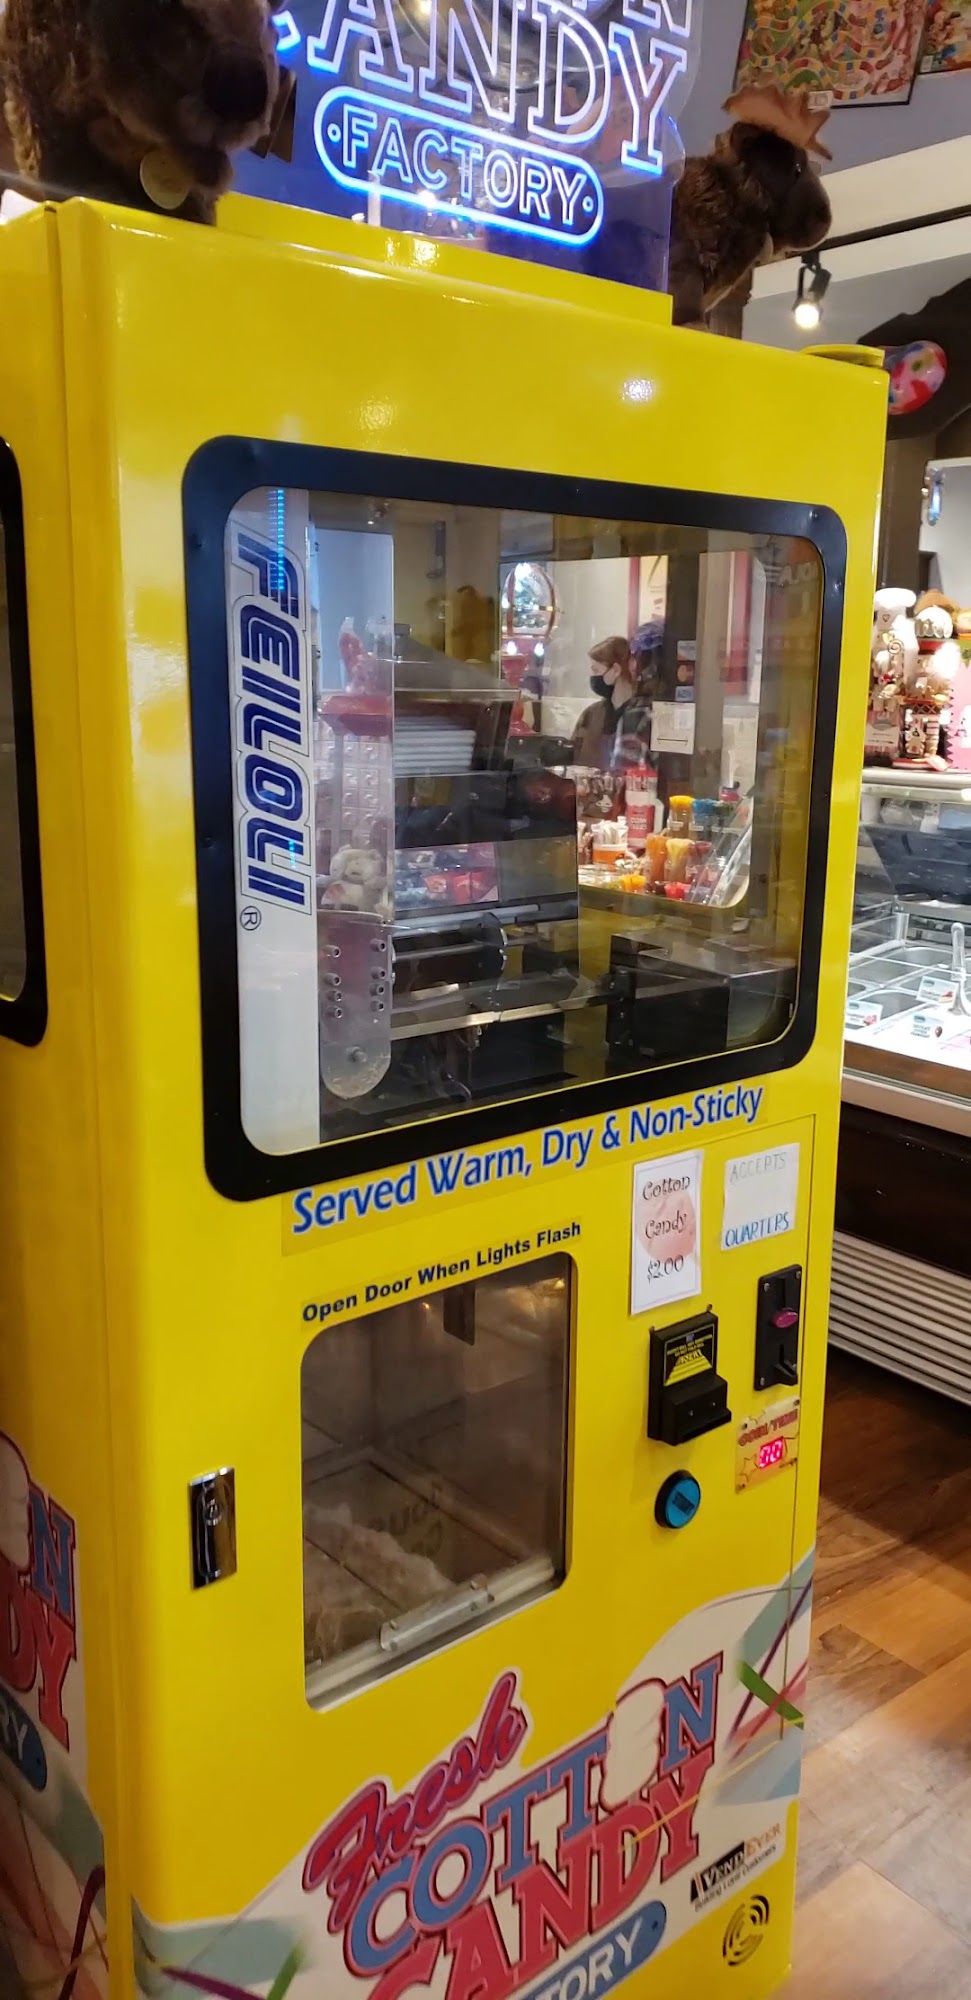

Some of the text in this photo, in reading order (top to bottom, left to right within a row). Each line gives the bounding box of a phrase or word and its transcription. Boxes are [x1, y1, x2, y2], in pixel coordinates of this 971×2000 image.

[272, 0, 687, 174] ANDY
[343, 104, 588, 226] FACTORY
[237, 532, 306, 906] FEILOLI
[292, 1084, 764, 1234] Served Warm, Dry & Non-Sticky
[642, 1173, 691, 1202] Cotton
[730, 1151, 787, 1185] ACCEPTS
[302, 1221, 581, 1322] Open Door When Lights Flash
[645, 1209, 688, 1240] Candy
[647, 1254, 684, 1284] $2.00
[725, 1210, 790, 1248] QUARTERS
[303, 1671, 527, 1934] Fresh
